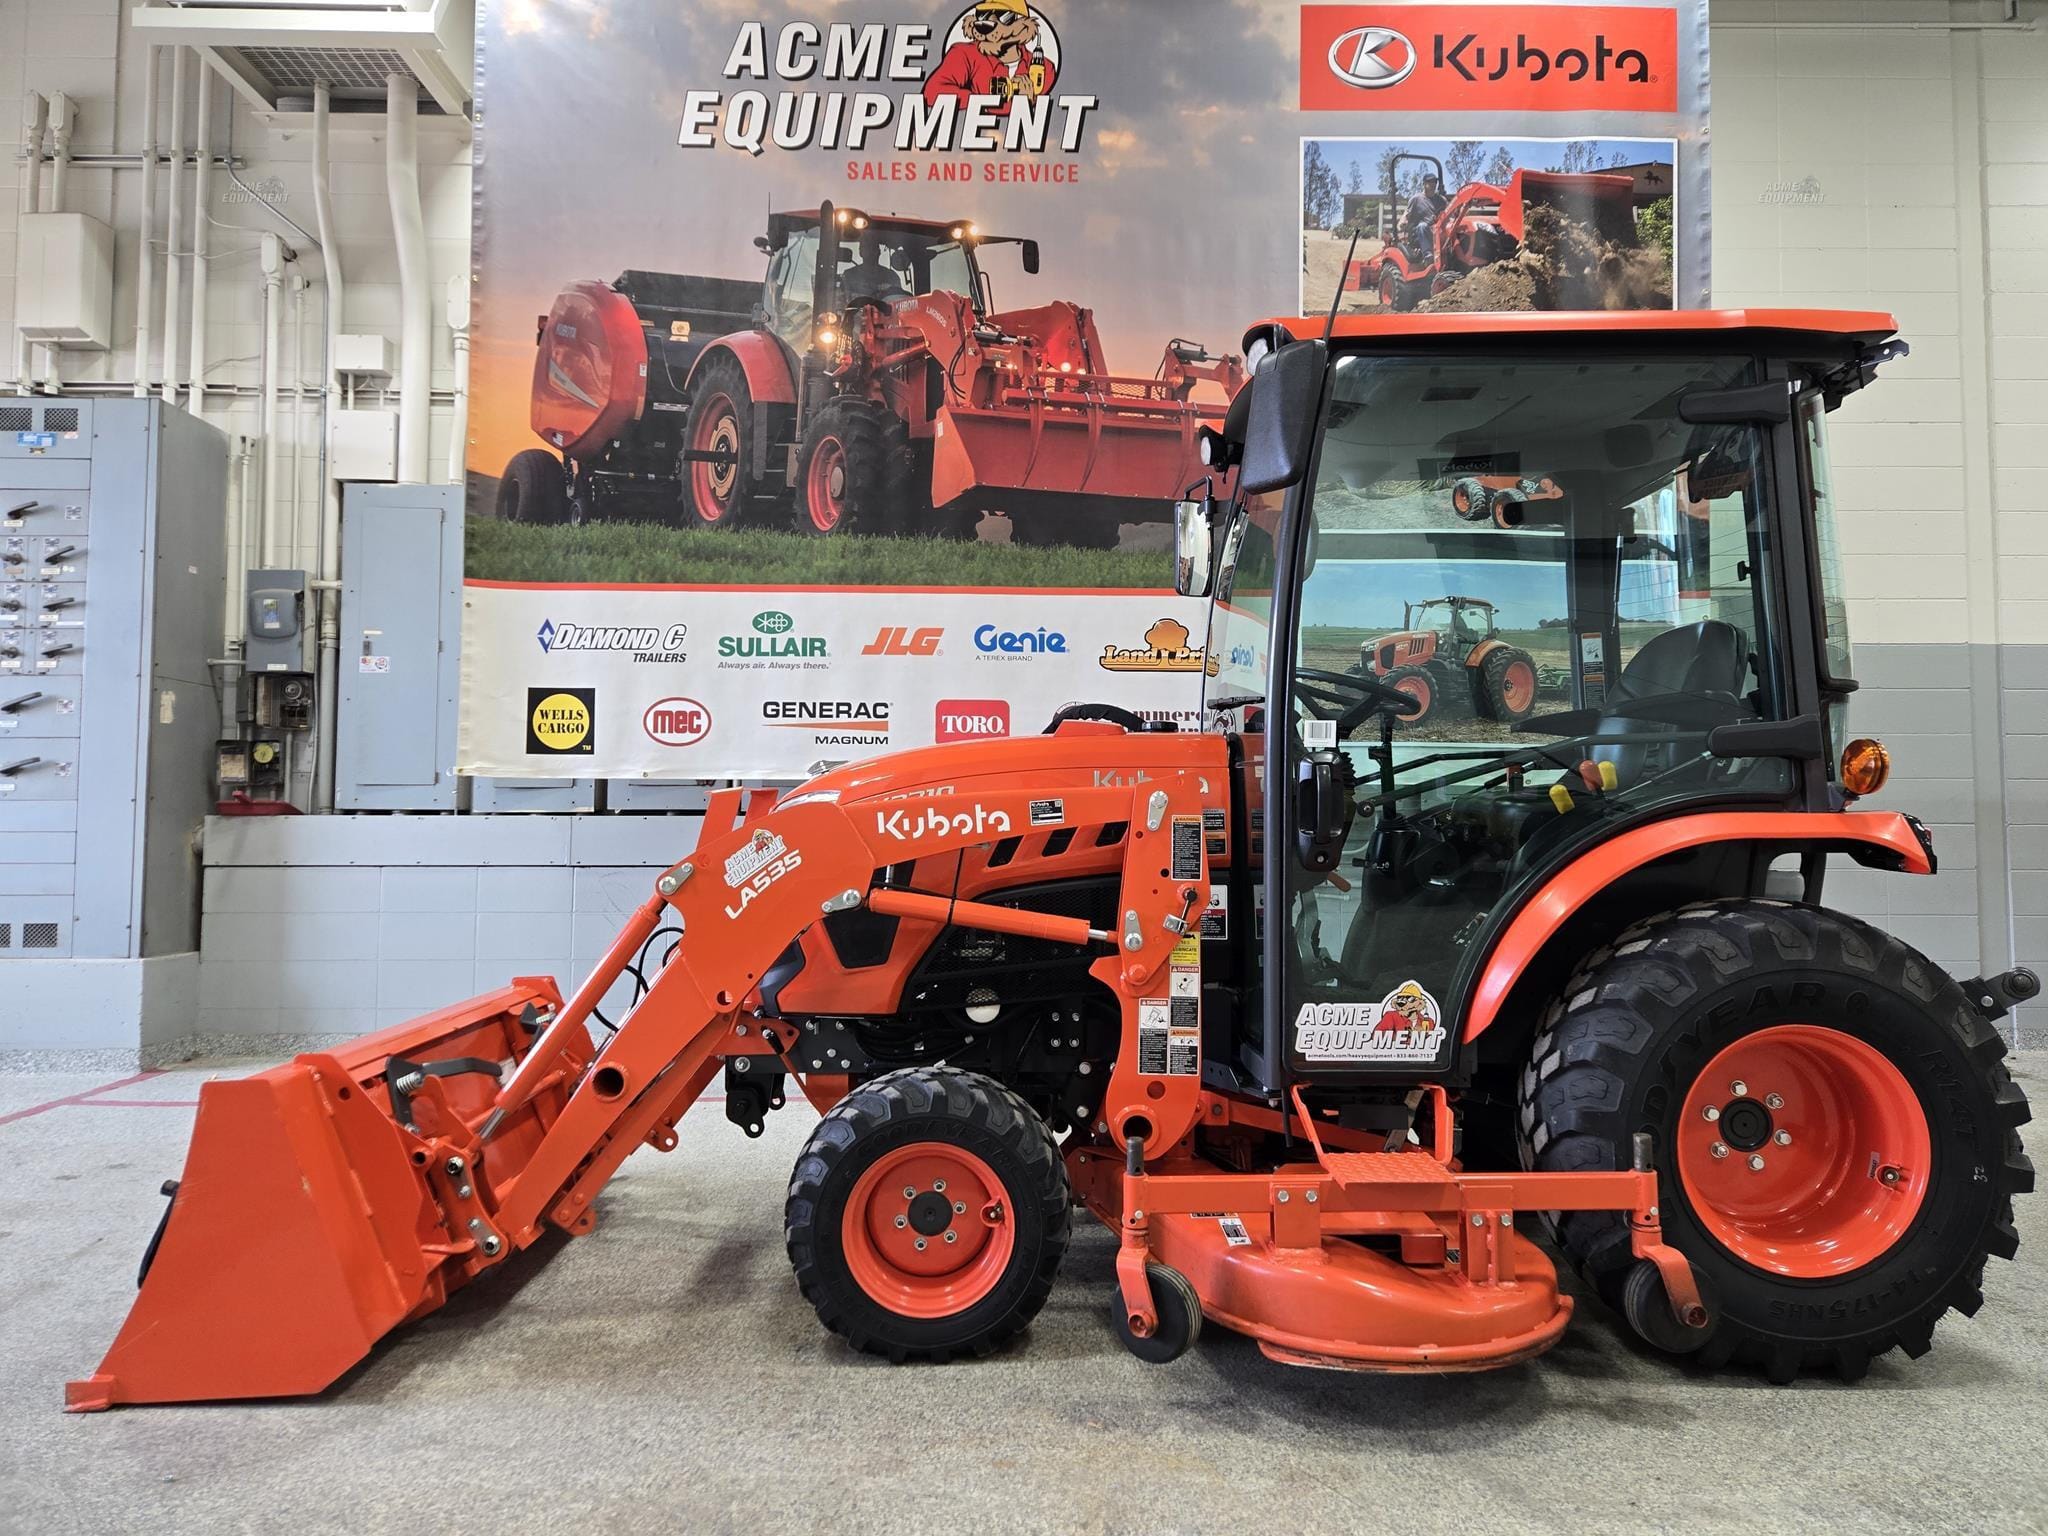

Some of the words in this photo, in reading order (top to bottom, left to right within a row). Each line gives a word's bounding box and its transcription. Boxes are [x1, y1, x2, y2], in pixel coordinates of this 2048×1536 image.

[722, 21, 932, 82] ACME
[1434, 34, 1649, 82] Kubota
[676, 89, 1099, 157] EQUIPMENT
[846, 161, 918, 183] SALES
[927, 162, 974, 183] AND
[984, 162, 1080, 183] SERVICE
[550, 623, 660, 651] DIAMOND
[663, 623, 688, 651] C
[718, 636, 827, 657] SULLAIR
[861, 627, 945, 655] JLG
[974, 624, 1067, 653] Genie
[633, 653, 687, 663] TRAILERS
[718, 661, 750, 670] Always
[768, 661, 801, 670] Always
[1104, 645, 1159, 664] Land
[539, 709, 584, 720] WELLS
[762, 701, 889, 719] GENERAC
[537, 722, 585, 734] CARGO
[941, 715, 1004, 734] TORO
[815, 736, 889, 745] MAGNUM
[877, 803, 1011, 840] Kubota
[725, 836, 784, 885] EQUIPMENT
[724, 849, 802, 920] LA535
[1300, 1006, 1371, 1027] ACME
[1300, 1029, 1443, 1051] EQUIPMENT
